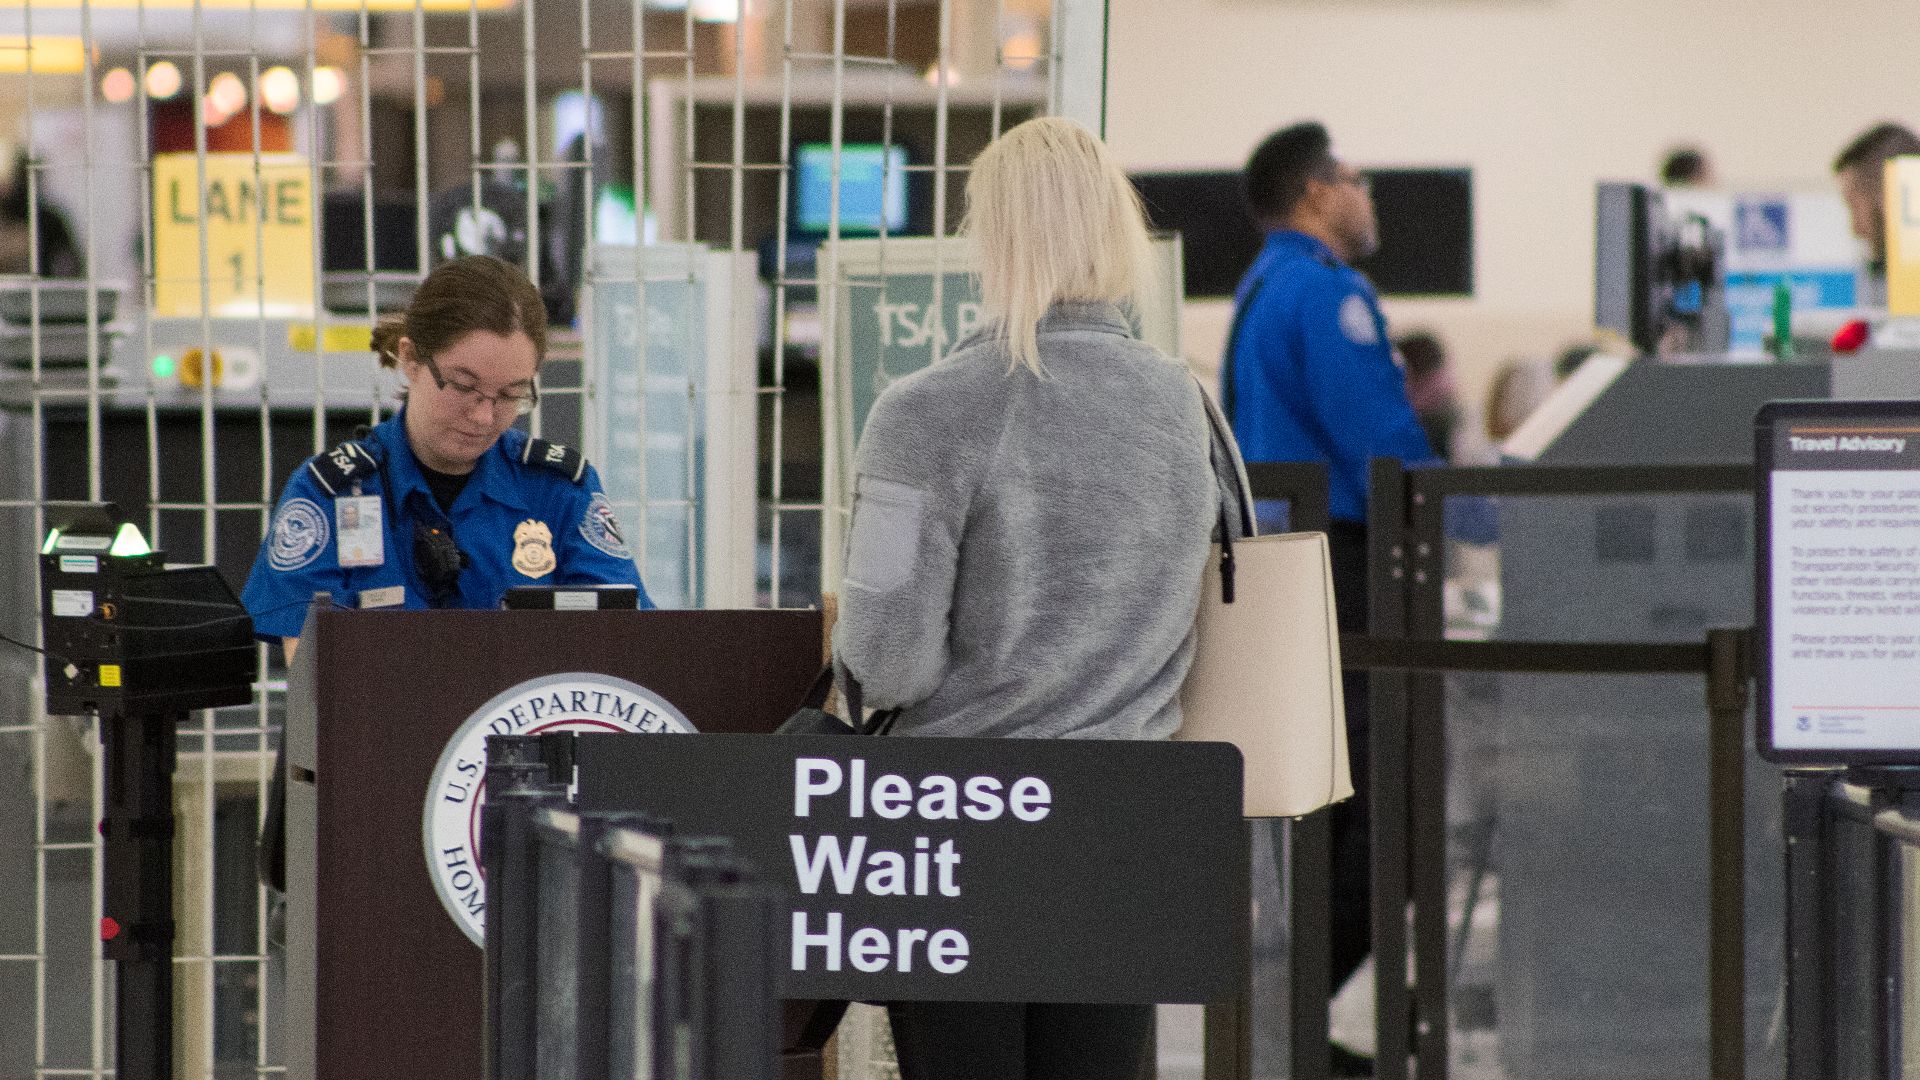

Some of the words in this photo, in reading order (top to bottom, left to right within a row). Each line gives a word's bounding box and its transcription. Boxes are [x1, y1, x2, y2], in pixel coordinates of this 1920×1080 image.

[169, 180, 303, 224] LANE
[228, 252, 242, 293] 1
[873, 303, 949, 347] TSA
[545, 444, 566, 463] TSA
[1790, 436, 1838, 451] Travel
[1839, 436, 1907, 454] Advisory
[327, 448, 356, 475] TSA
[1791, 487, 1823, 499] Thank
[1828, 490, 1847, 501] you
[1850, 487, 1865, 498] for
[1870, 490, 1893, 501] your
[1812, 503, 1854, 516] security
[1791, 519, 1815, 530] your
[1819, 518, 1852, 530] safety
[1856, 518, 1876, 528] and
[1791, 546, 1803, 556] To
[1806, 547, 1845, 558] protect
[1849, 546, 1865, 556] the
[1869, 546, 1901, 558] safety
[1906, 545, 1917, 556] of
[1791, 561, 1870, 573] Transportation
[1873, 561, 1917, 573] Security
[1791, 576, 1819, 587] other
[1823, 576, 1882, 587] individuals
[1791, 604, 1835, 615] violence
[1839, 603, 1852, 615] of
[1854, 606, 1873, 617] any
[1877, 604, 1902, 615] kind
[1791, 634, 1825, 645] Please
[1829, 635, 1872, 647] proceed
[1875, 635, 1887, 645] to
[1891, 636, 1913, 647] your
[1791, 648, 1812, 658] and
[1815, 648, 1845, 658] thank
[1850, 650, 1869, 661] you
[1872, 648, 1888, 658] for
[1891, 650, 1915, 661] your
[443, 757, 483, 804] U.S.
[794, 757, 1053, 822] Please
[788, 834, 962, 898] Wait
[790, 911, 971, 975] Here
